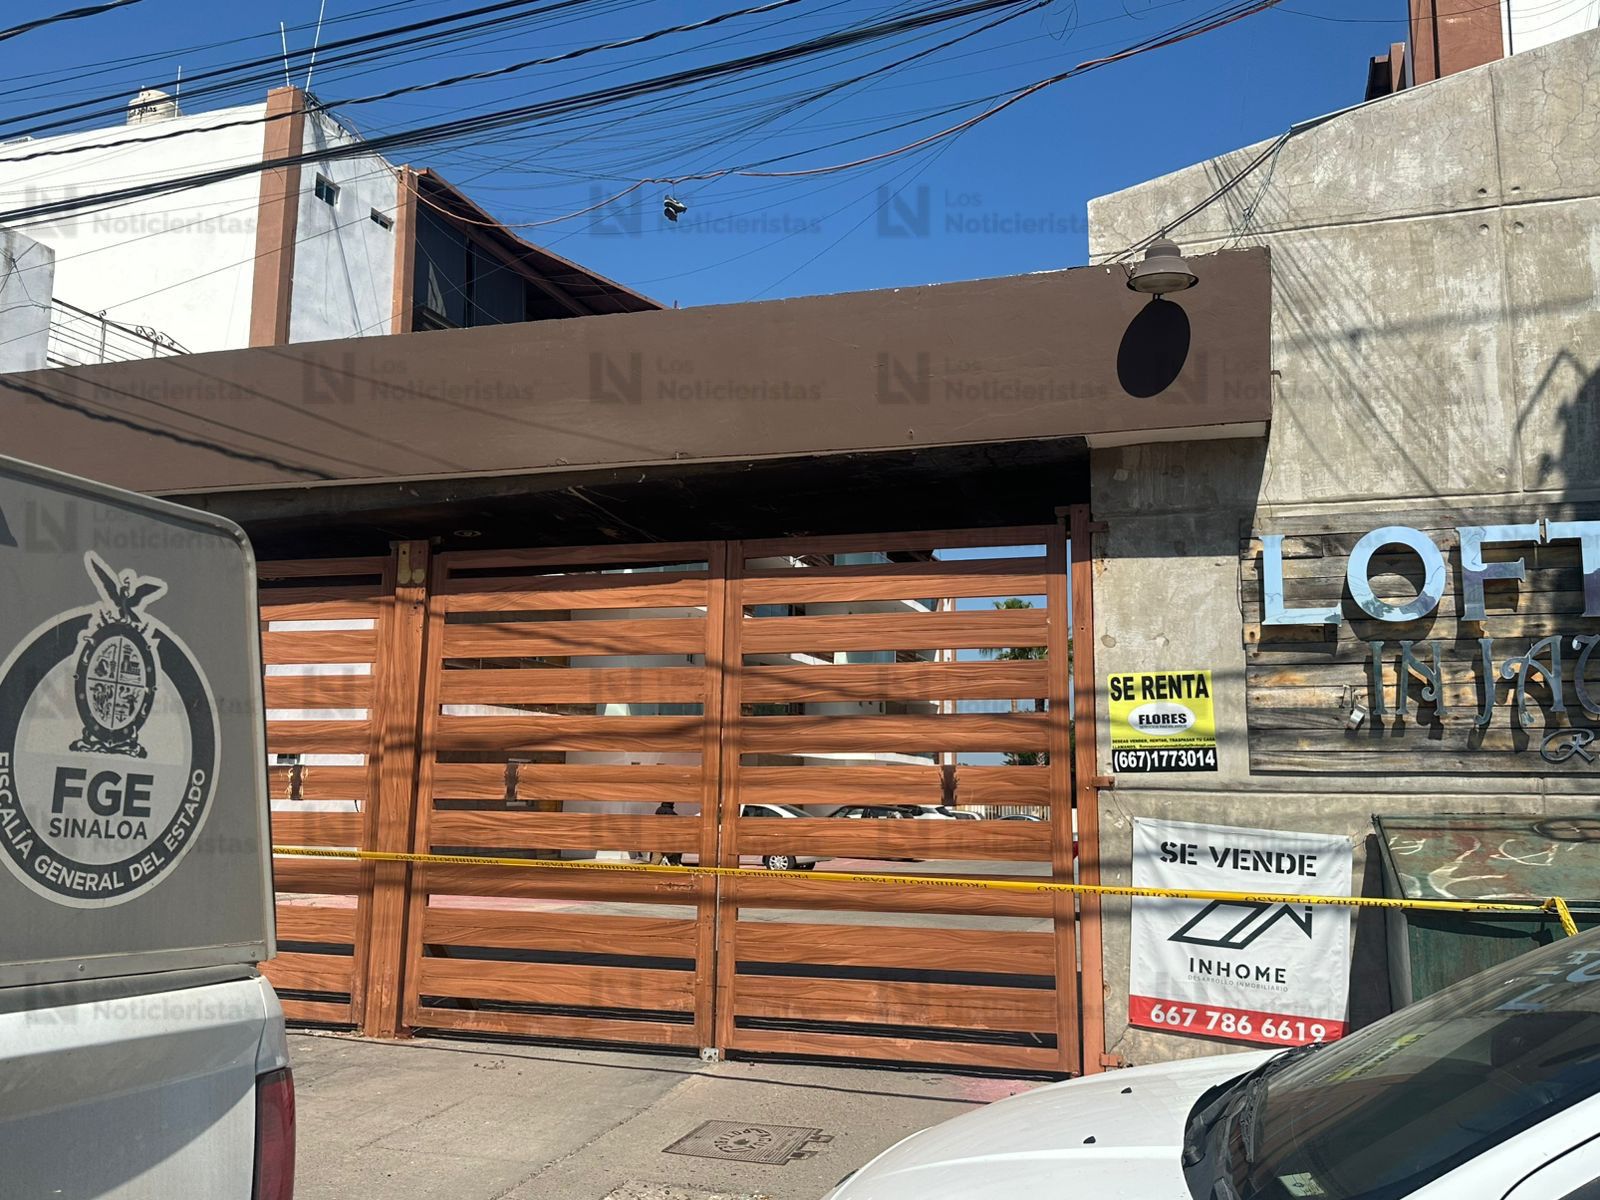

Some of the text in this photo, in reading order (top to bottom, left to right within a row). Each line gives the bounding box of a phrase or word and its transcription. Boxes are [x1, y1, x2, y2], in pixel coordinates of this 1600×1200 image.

[1110, 673, 1210, 702] SE RENTA
[1138, 713, 1188, 725] FLORES
[1114, 750, 1216, 772] (667)1773014
[51, 766, 154, 818] FGE
[34, 855, 125, 891] GENERAL
[129, 851, 165, 883] DEL
[163, 768, 206, 853] ESTADO
[48, 817, 148, 840] SINALOA
[1159, 841, 1318, 877] SE VENDE
[1188, 957, 1287, 984] INHOME
[1188, 974, 1289, 993] DESARROLLO INMOBILIARIO
[1150, 1003, 1198, 1028] 667
[1205, 1010, 1252, 1035] 786
[1260, 1017, 1326, 1043] 6619
